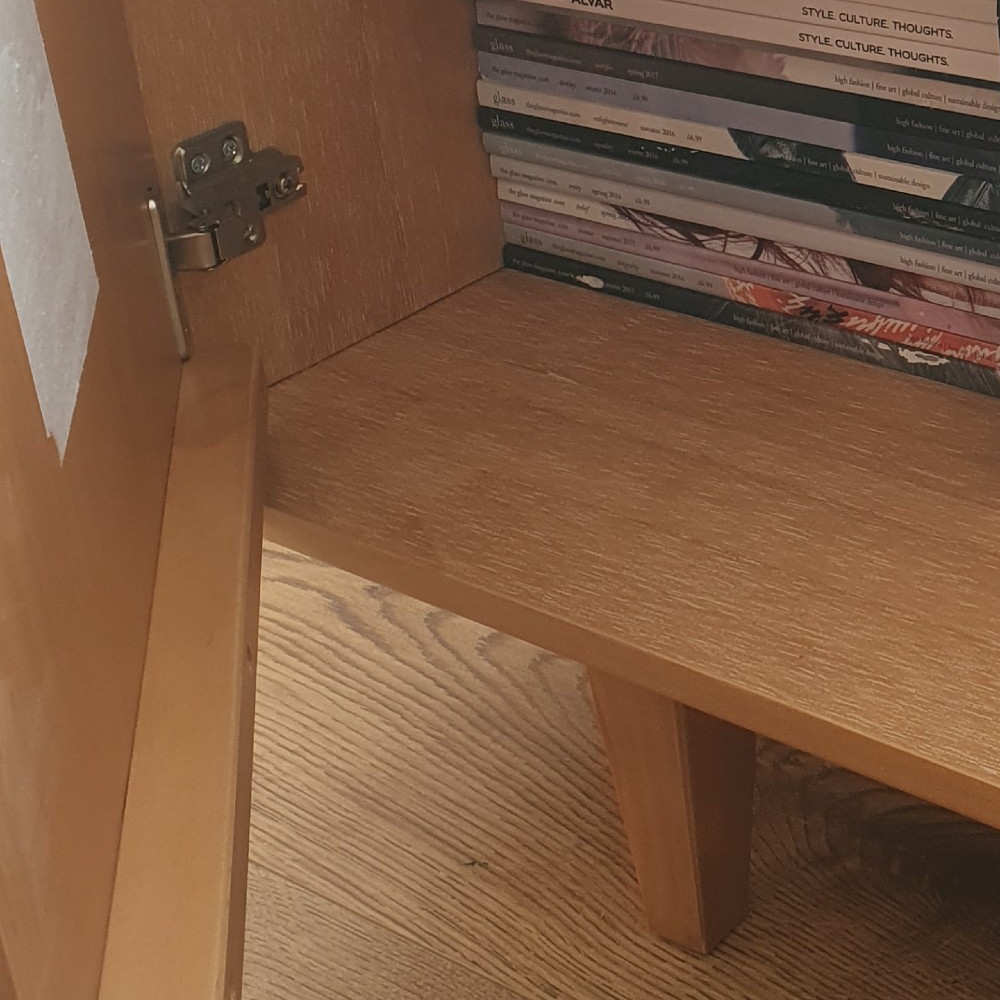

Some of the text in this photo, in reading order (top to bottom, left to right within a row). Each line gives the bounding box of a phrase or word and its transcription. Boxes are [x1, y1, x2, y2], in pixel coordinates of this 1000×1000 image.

[892, 21, 953, 39] THOUGHTS.
[888, 48, 949, 66] THOUGHTS.
[492, 91, 516, 107] glass
[835, 75, 848, 85] high
[849, 78, 870, 88] fashion
[902, 89, 920, 98] global
[922, 92, 942, 101] culture
[948, 97, 981, 108] sustainable
[491, 114, 515, 129] glass
